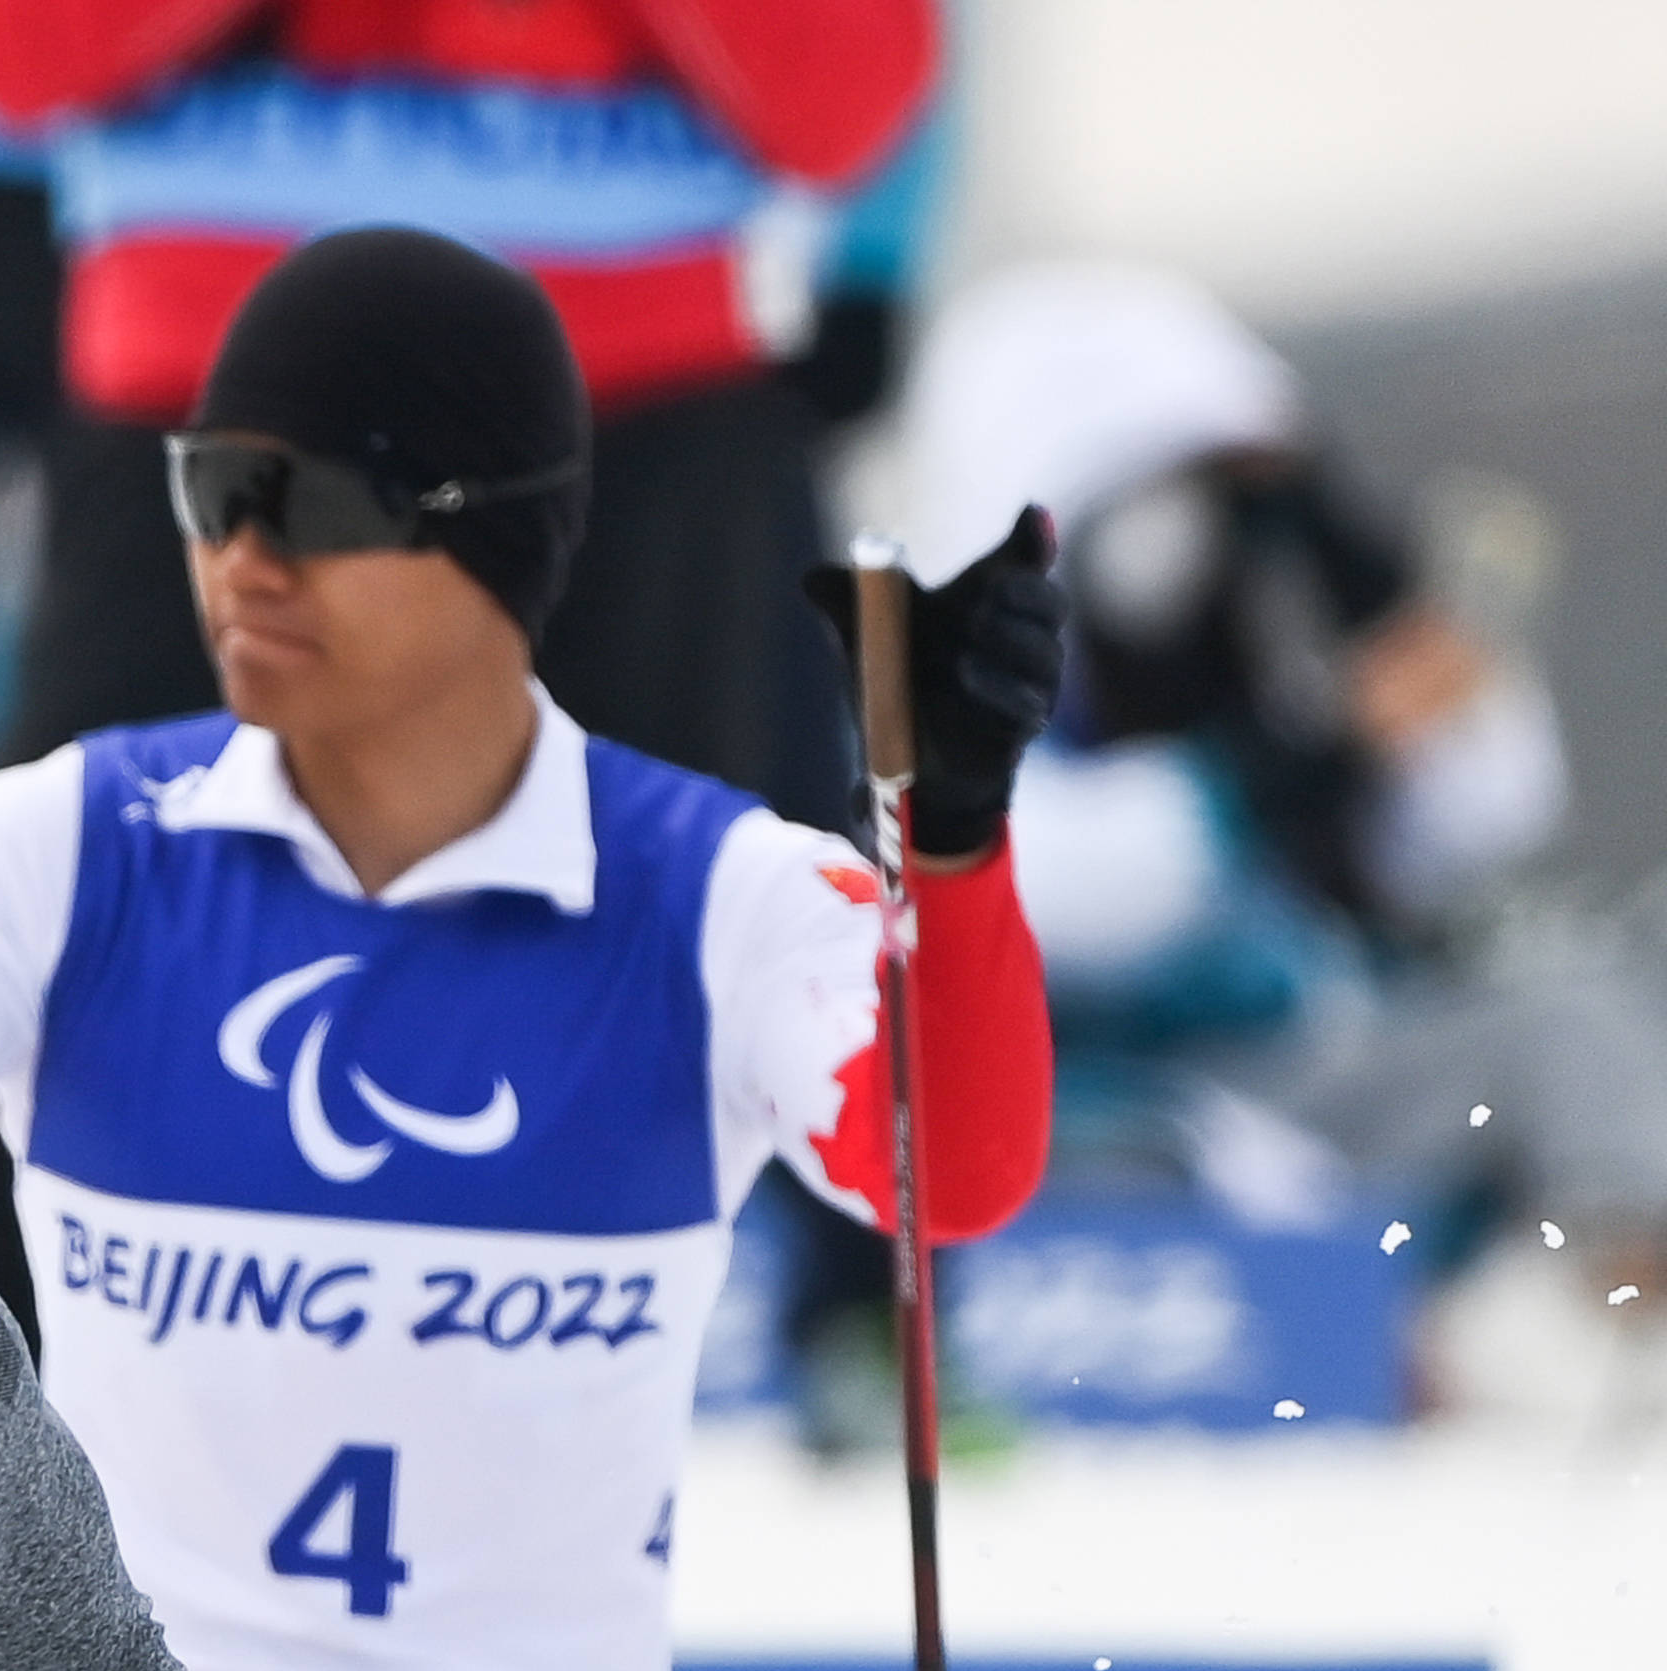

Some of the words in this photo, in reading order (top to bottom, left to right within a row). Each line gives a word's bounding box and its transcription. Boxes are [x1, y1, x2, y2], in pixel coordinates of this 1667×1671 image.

[58, 1213, 372, 1349] BEIJING
[410, 1269, 664, 1350] 2022
[268, 1444, 410, 1619] 4
